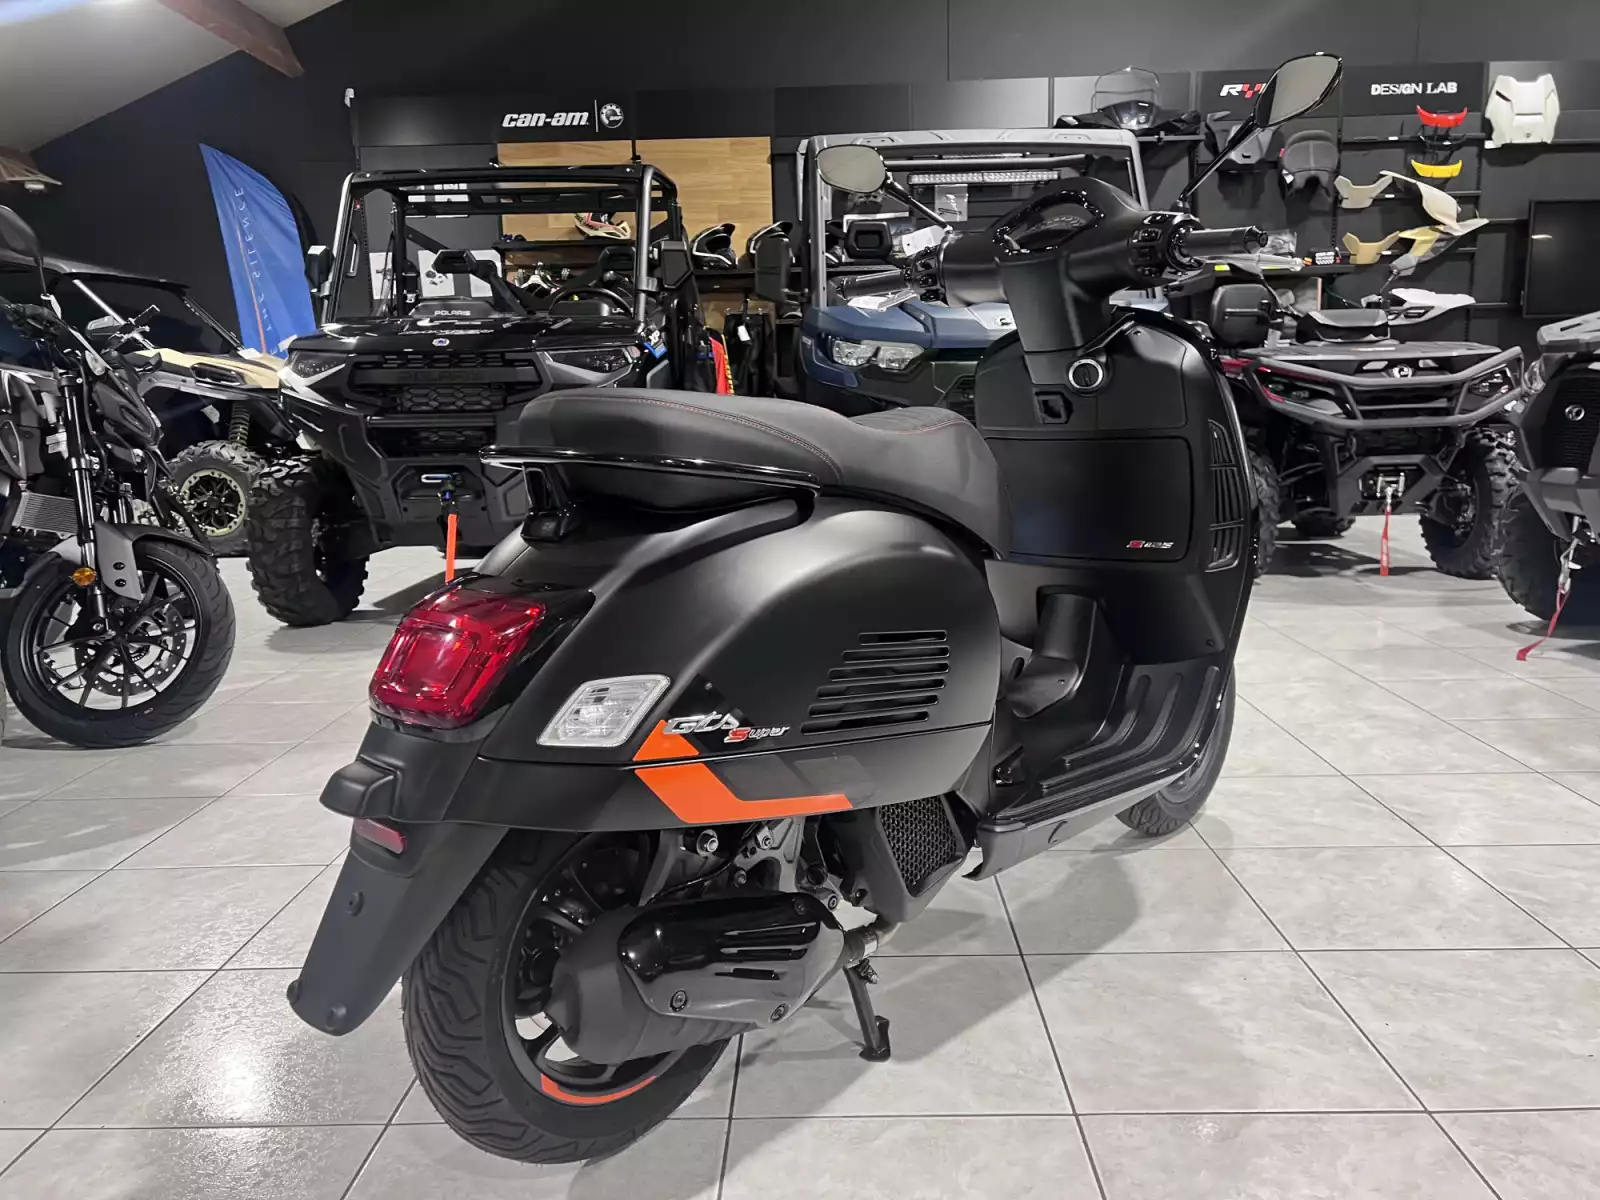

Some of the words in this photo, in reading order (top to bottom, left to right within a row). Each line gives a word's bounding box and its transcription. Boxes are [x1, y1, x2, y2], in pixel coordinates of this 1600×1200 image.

[1371, 83, 1422, 95] DESIGN
[1426, 82, 1458, 94] LAB
[502, 112, 589, 127] can-am
[723, 726, 790, 743] Super
